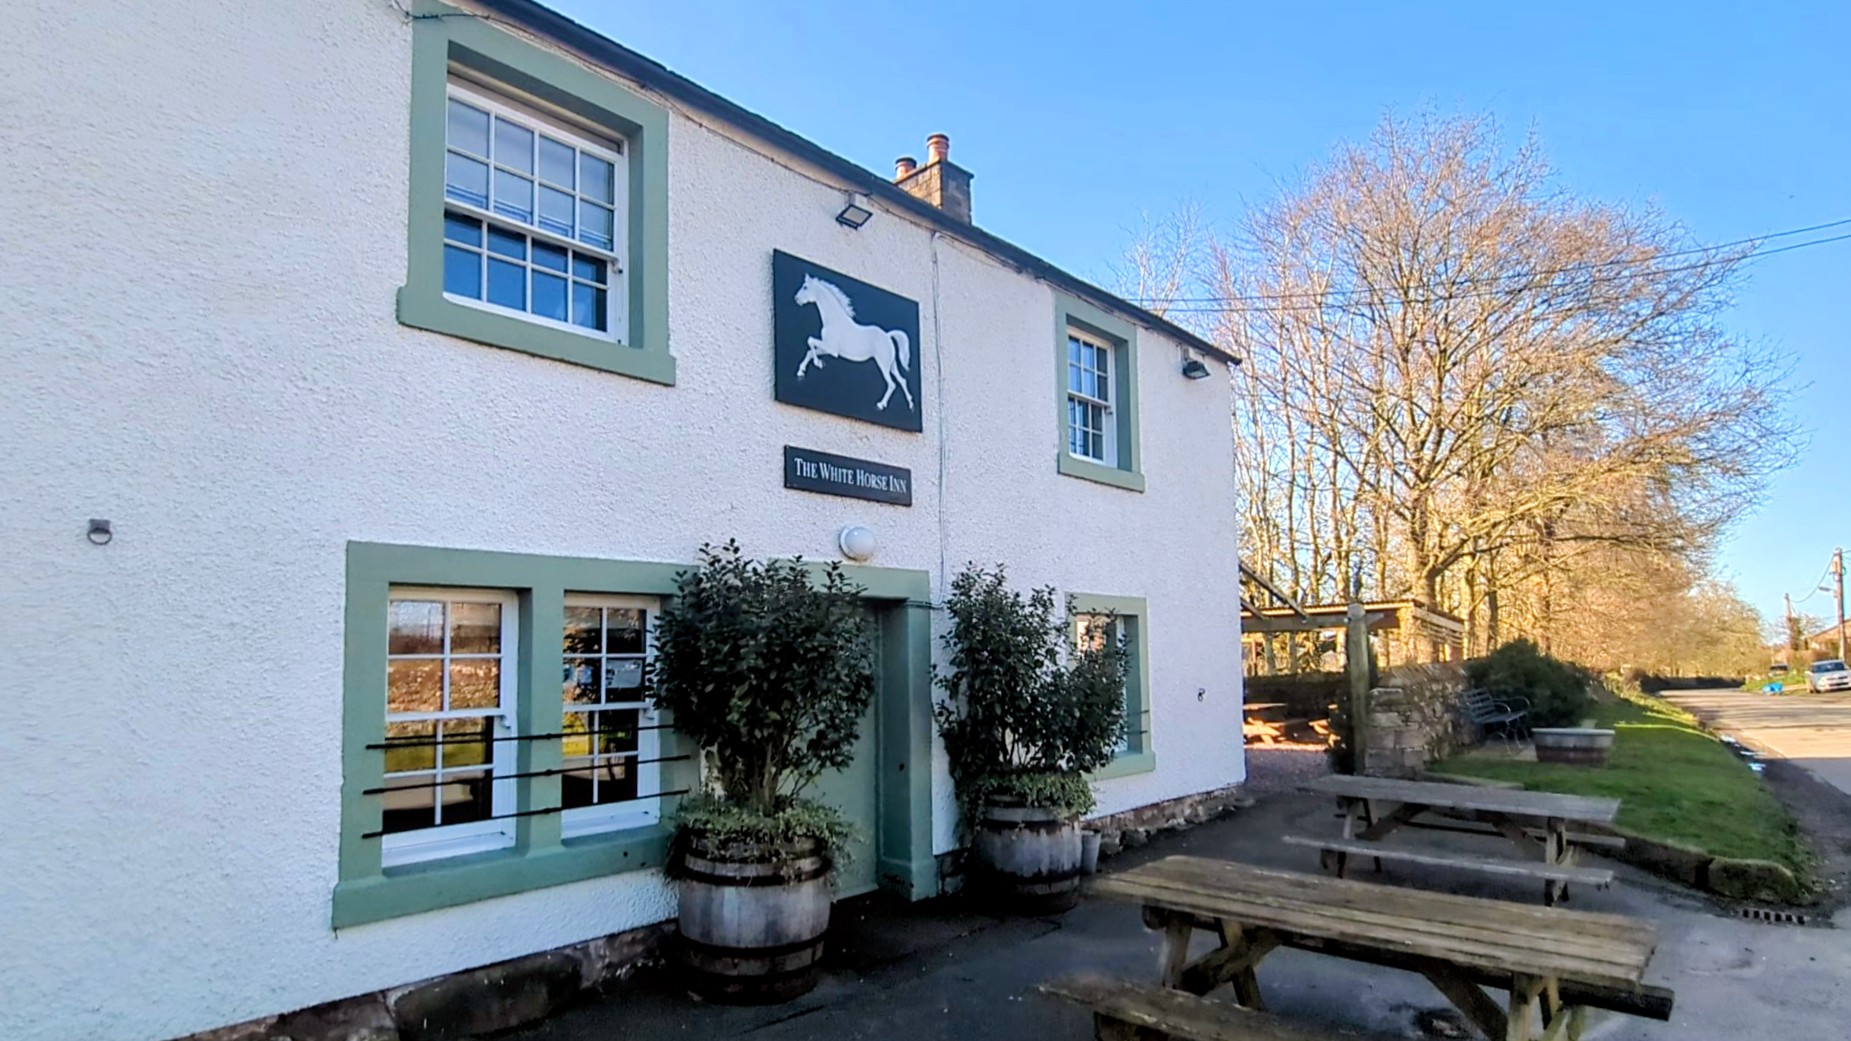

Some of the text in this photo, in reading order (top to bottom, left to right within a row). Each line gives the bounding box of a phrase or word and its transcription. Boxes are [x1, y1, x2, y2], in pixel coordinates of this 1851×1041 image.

[794, 457, 907, 494] THE WHITE HORSE INN
